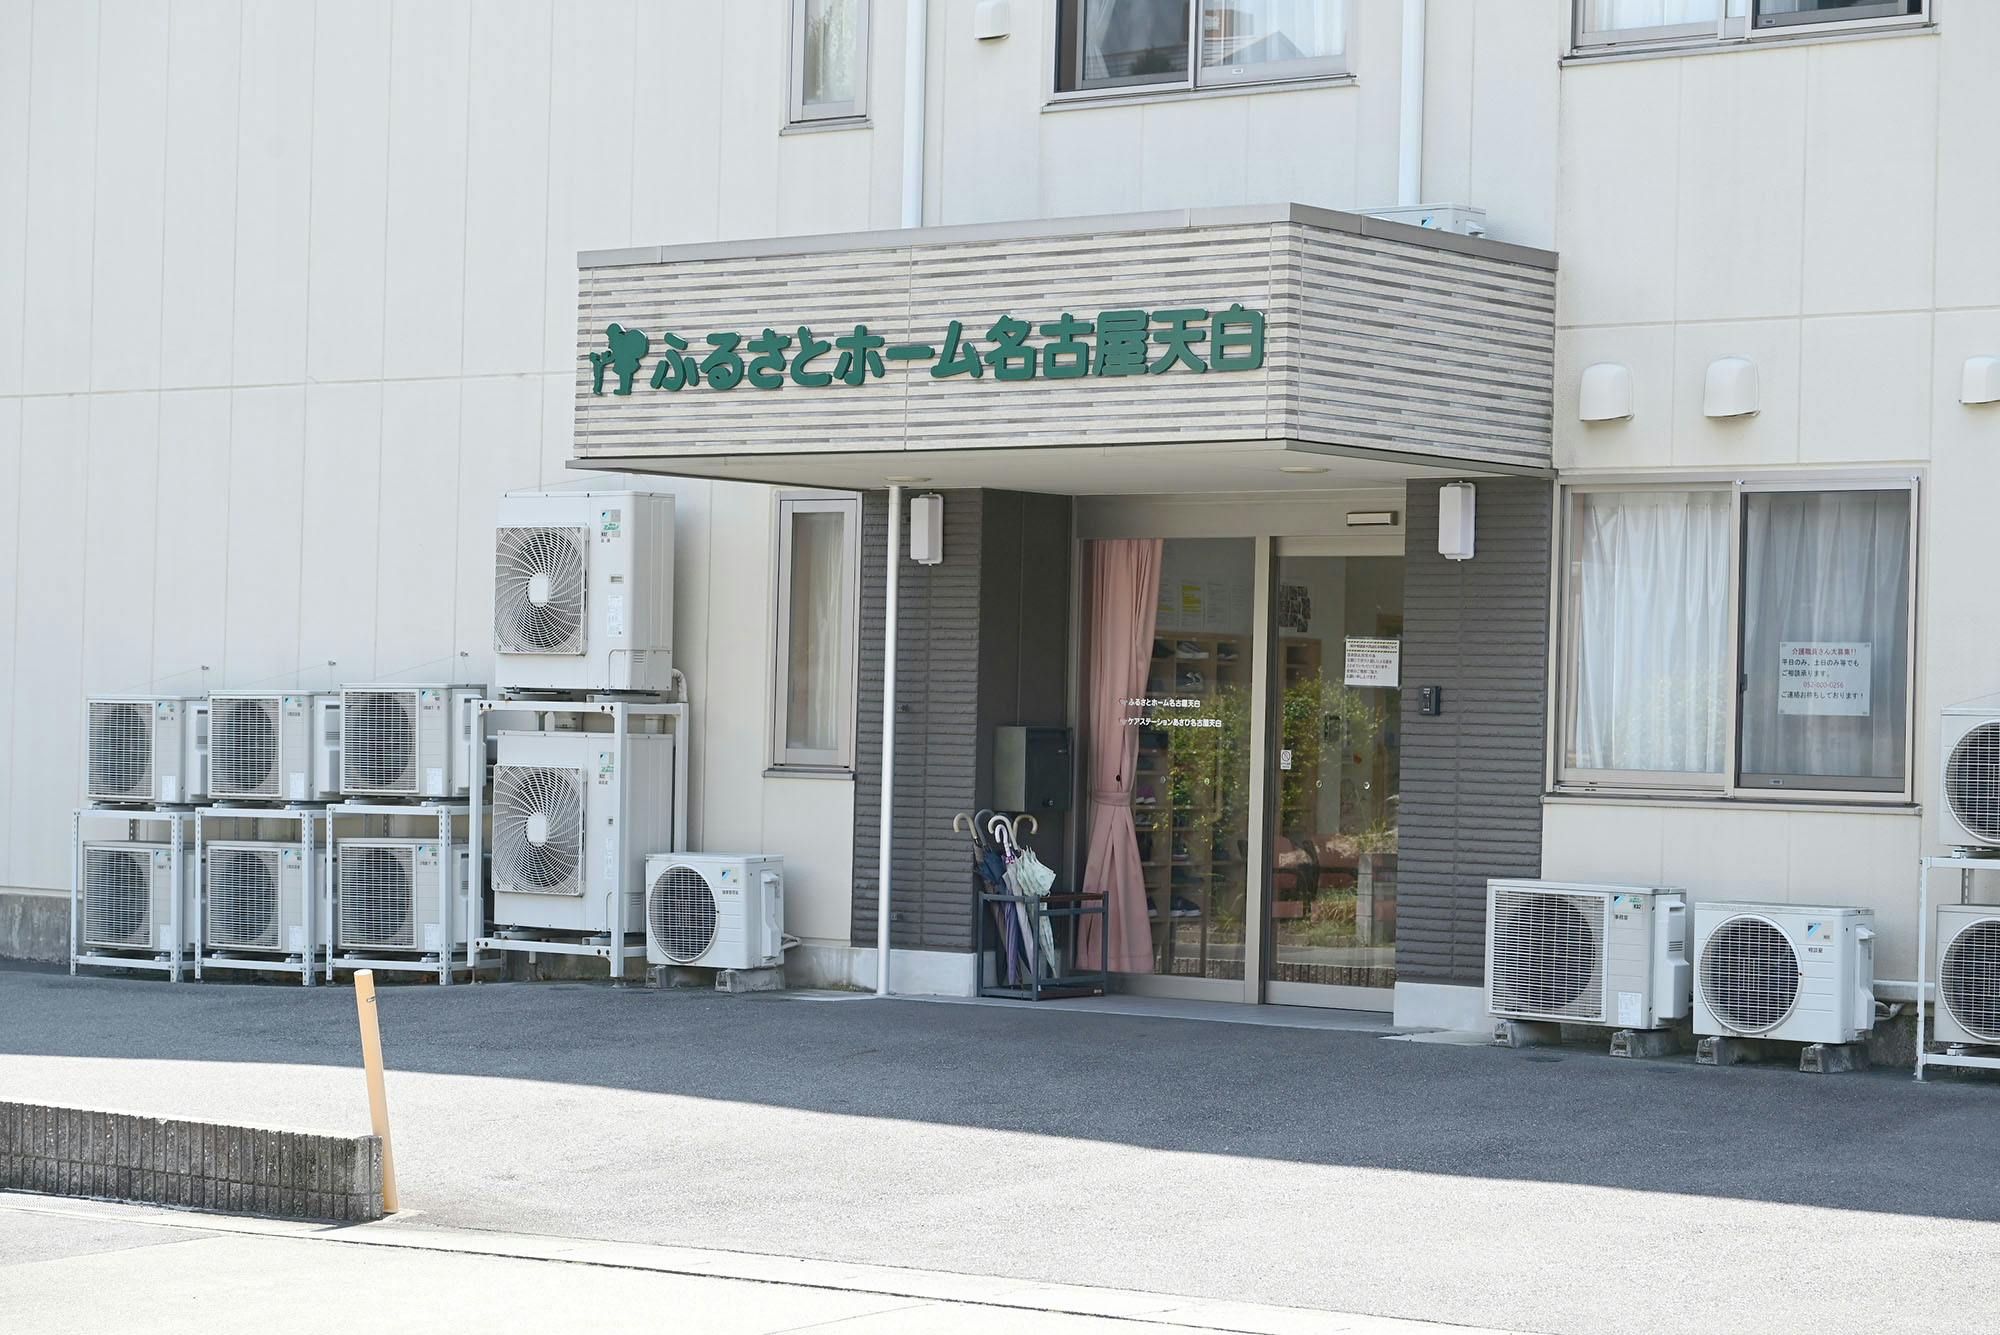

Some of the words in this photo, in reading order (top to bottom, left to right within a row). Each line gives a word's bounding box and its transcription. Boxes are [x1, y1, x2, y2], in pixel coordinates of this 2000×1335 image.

[651, 302, 1266, 393] ふるさとホーム名古屋天白
[1128, 698, 1201, 708] ふるさとホーム名古屋天白
[1128, 717, 1222, 728] ケアステーションあさひ名古屋天白
